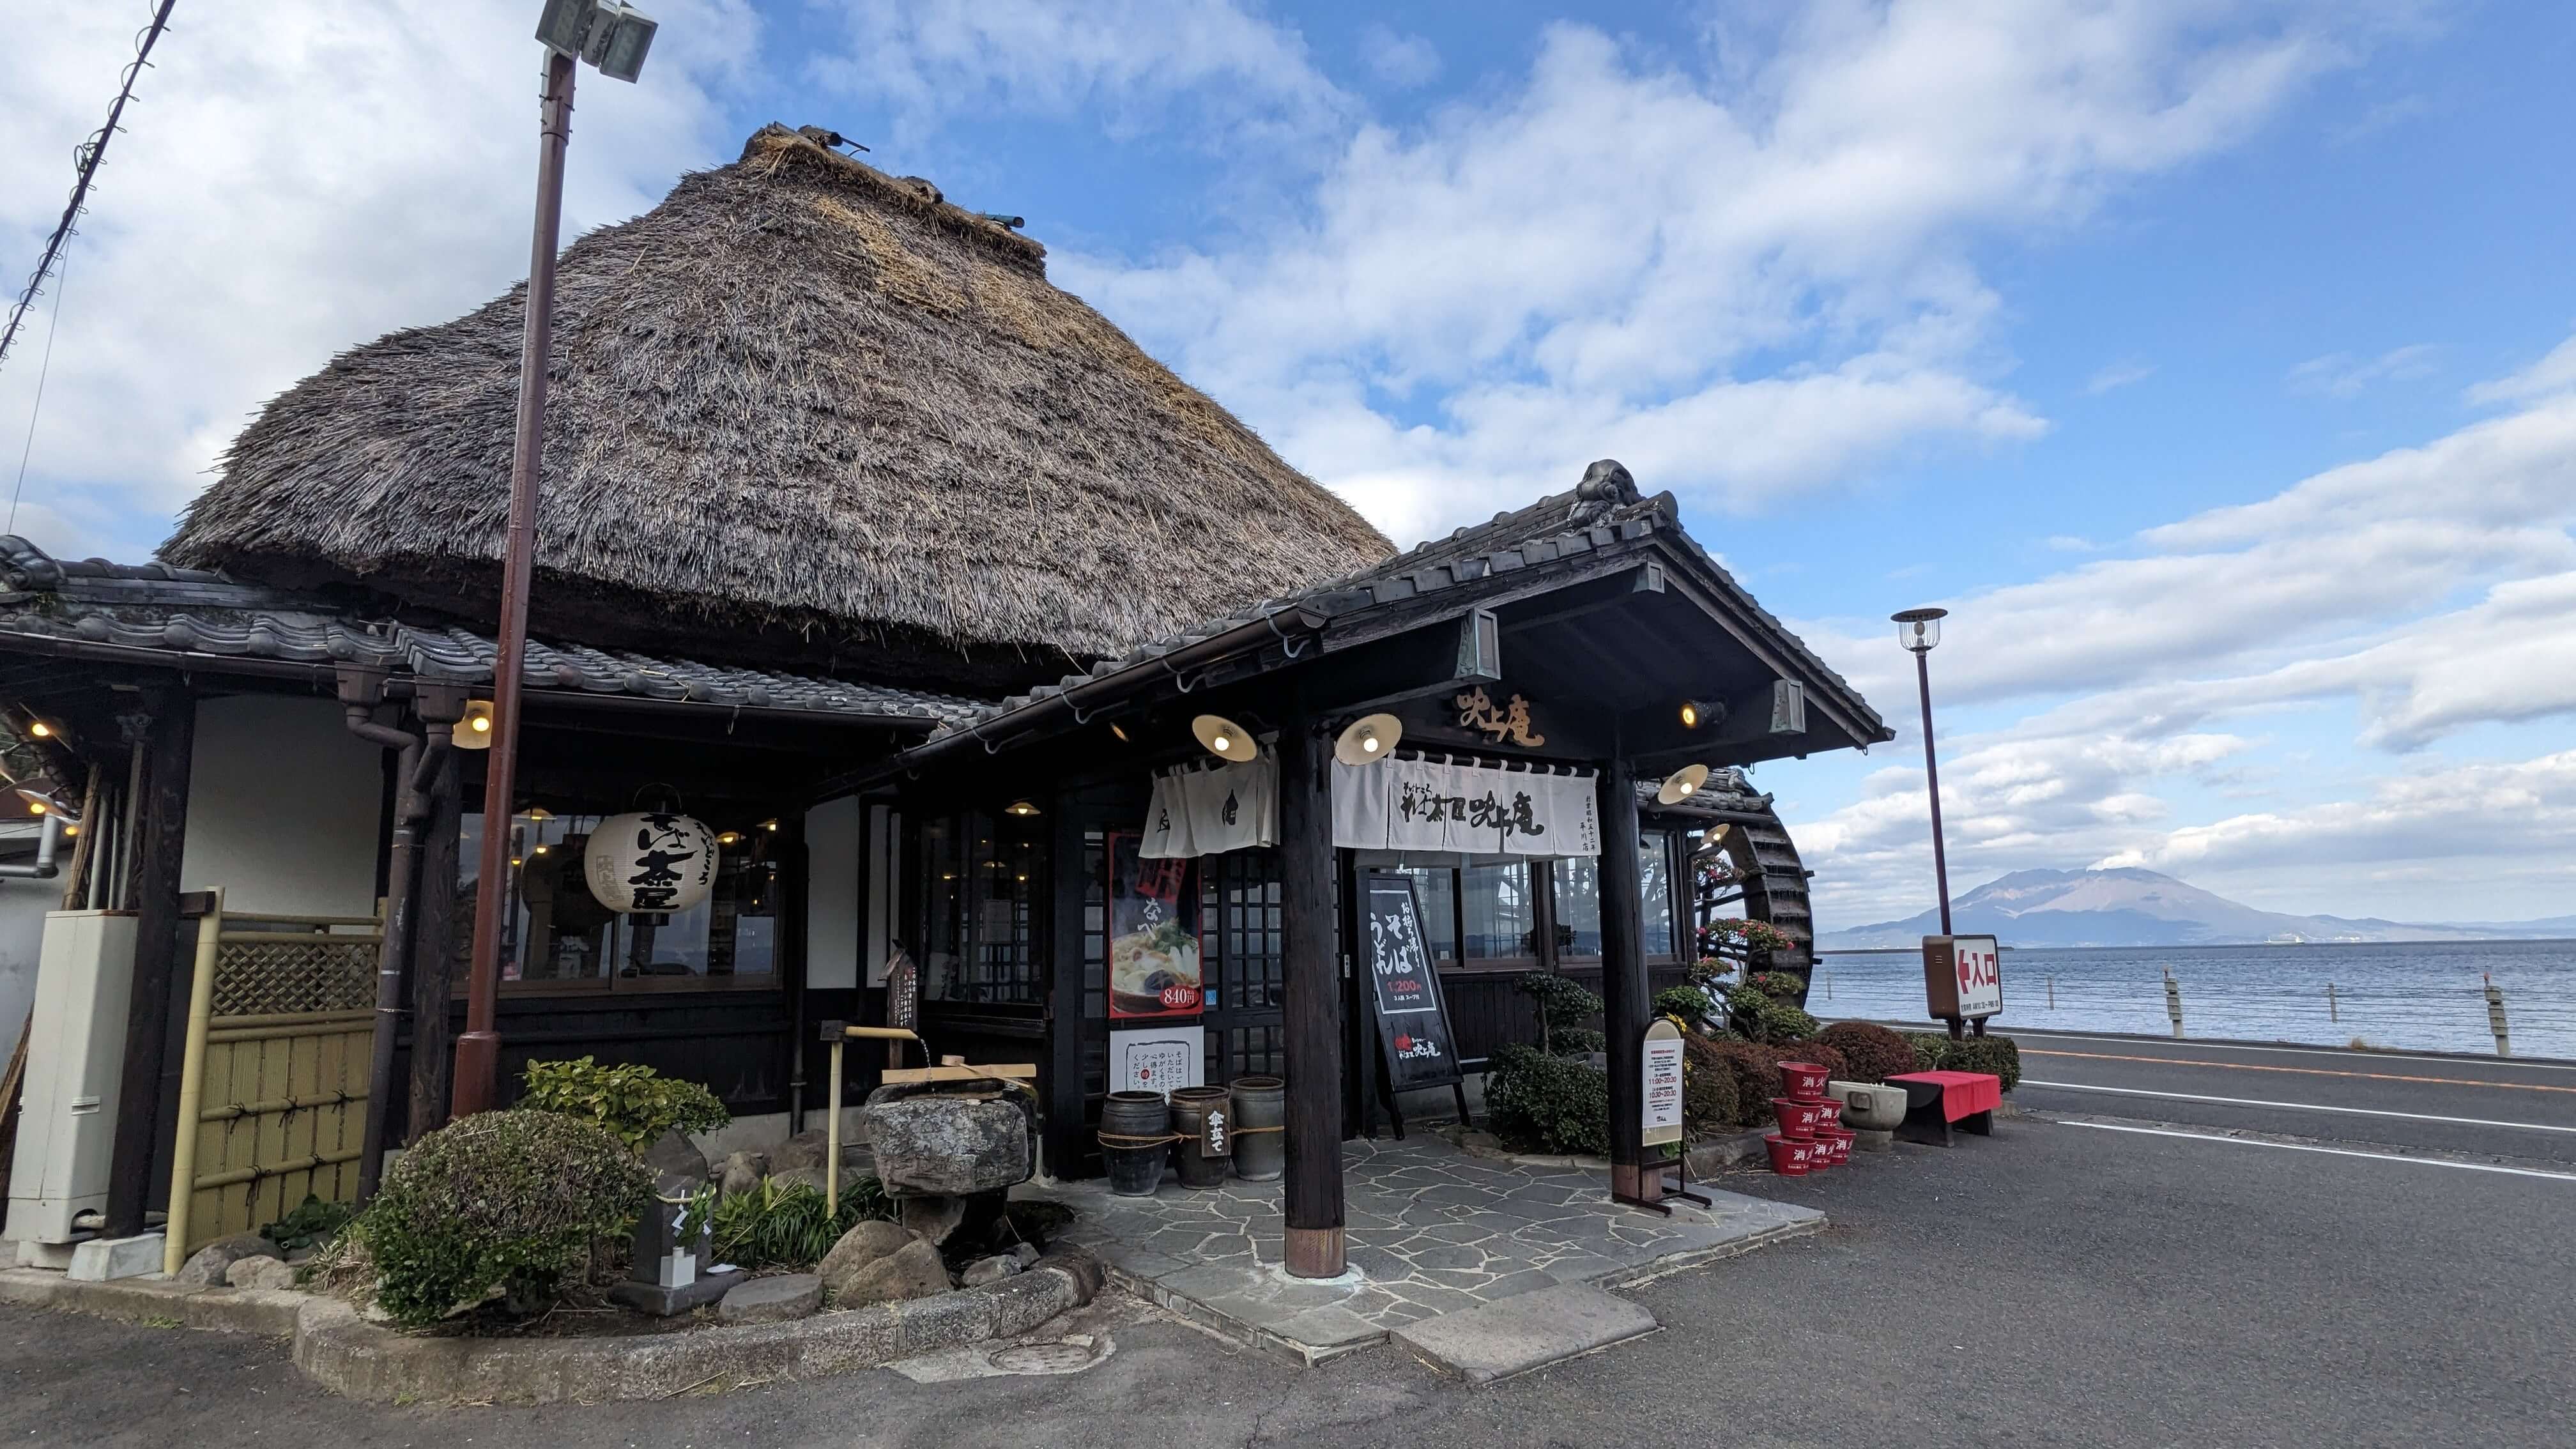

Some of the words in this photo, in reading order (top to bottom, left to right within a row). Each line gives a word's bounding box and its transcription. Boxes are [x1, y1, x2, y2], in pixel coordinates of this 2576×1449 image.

[1457, 686, 1545, 746] 吹上庵
[1580, 822, 1589, 852] 平川店
[1137, 896, 1162, 940] なべ
[1370, 912, 1393, 975] うどん
[1384, 914, 1413, 974] そば
[1972, 953, 1997, 988] 入口
[1164, 988, 1195, 1004] 840円
[1802, 1076, 1827, 1087] 消火
[1208, 1110, 1225, 1151] 傘立て
